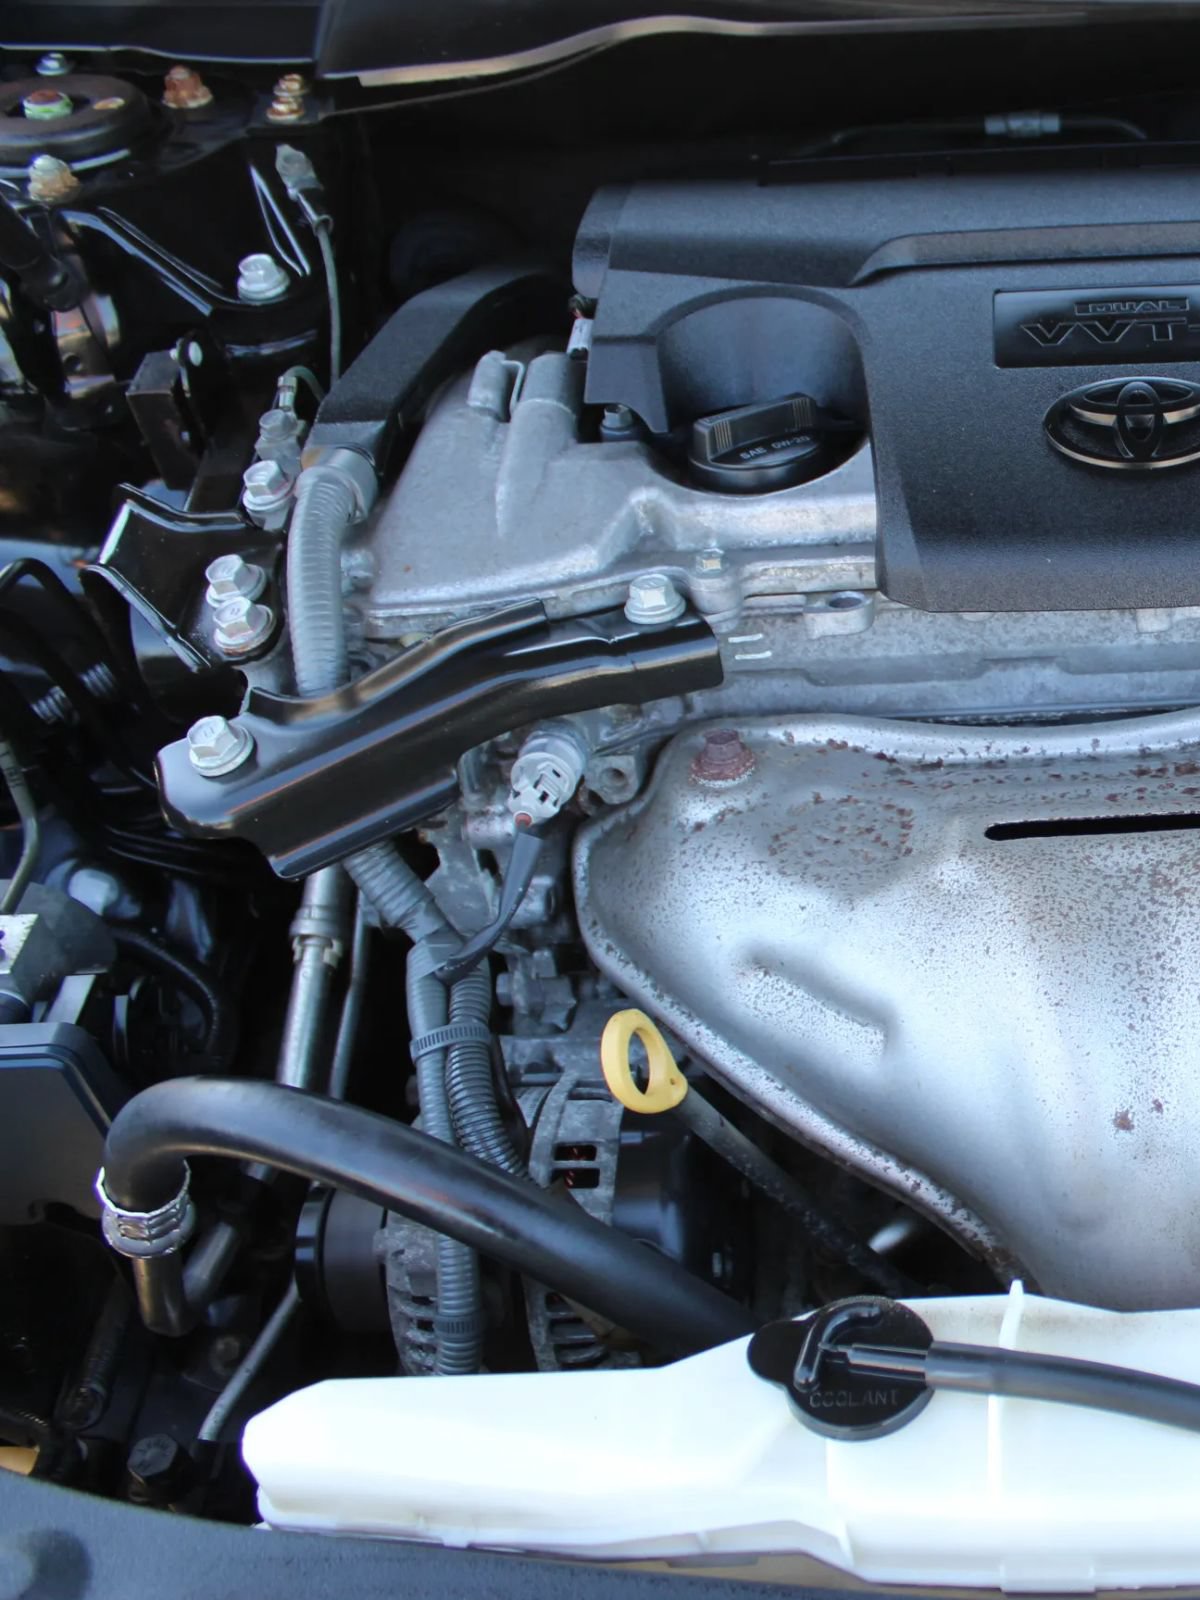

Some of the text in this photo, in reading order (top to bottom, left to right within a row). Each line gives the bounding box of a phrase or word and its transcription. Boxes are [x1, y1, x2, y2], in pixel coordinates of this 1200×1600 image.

[1082, 299, 1187, 314] DUAL
[739, 447, 768, 460] SAE
[809, 1389, 899, 1408] COOLANT
